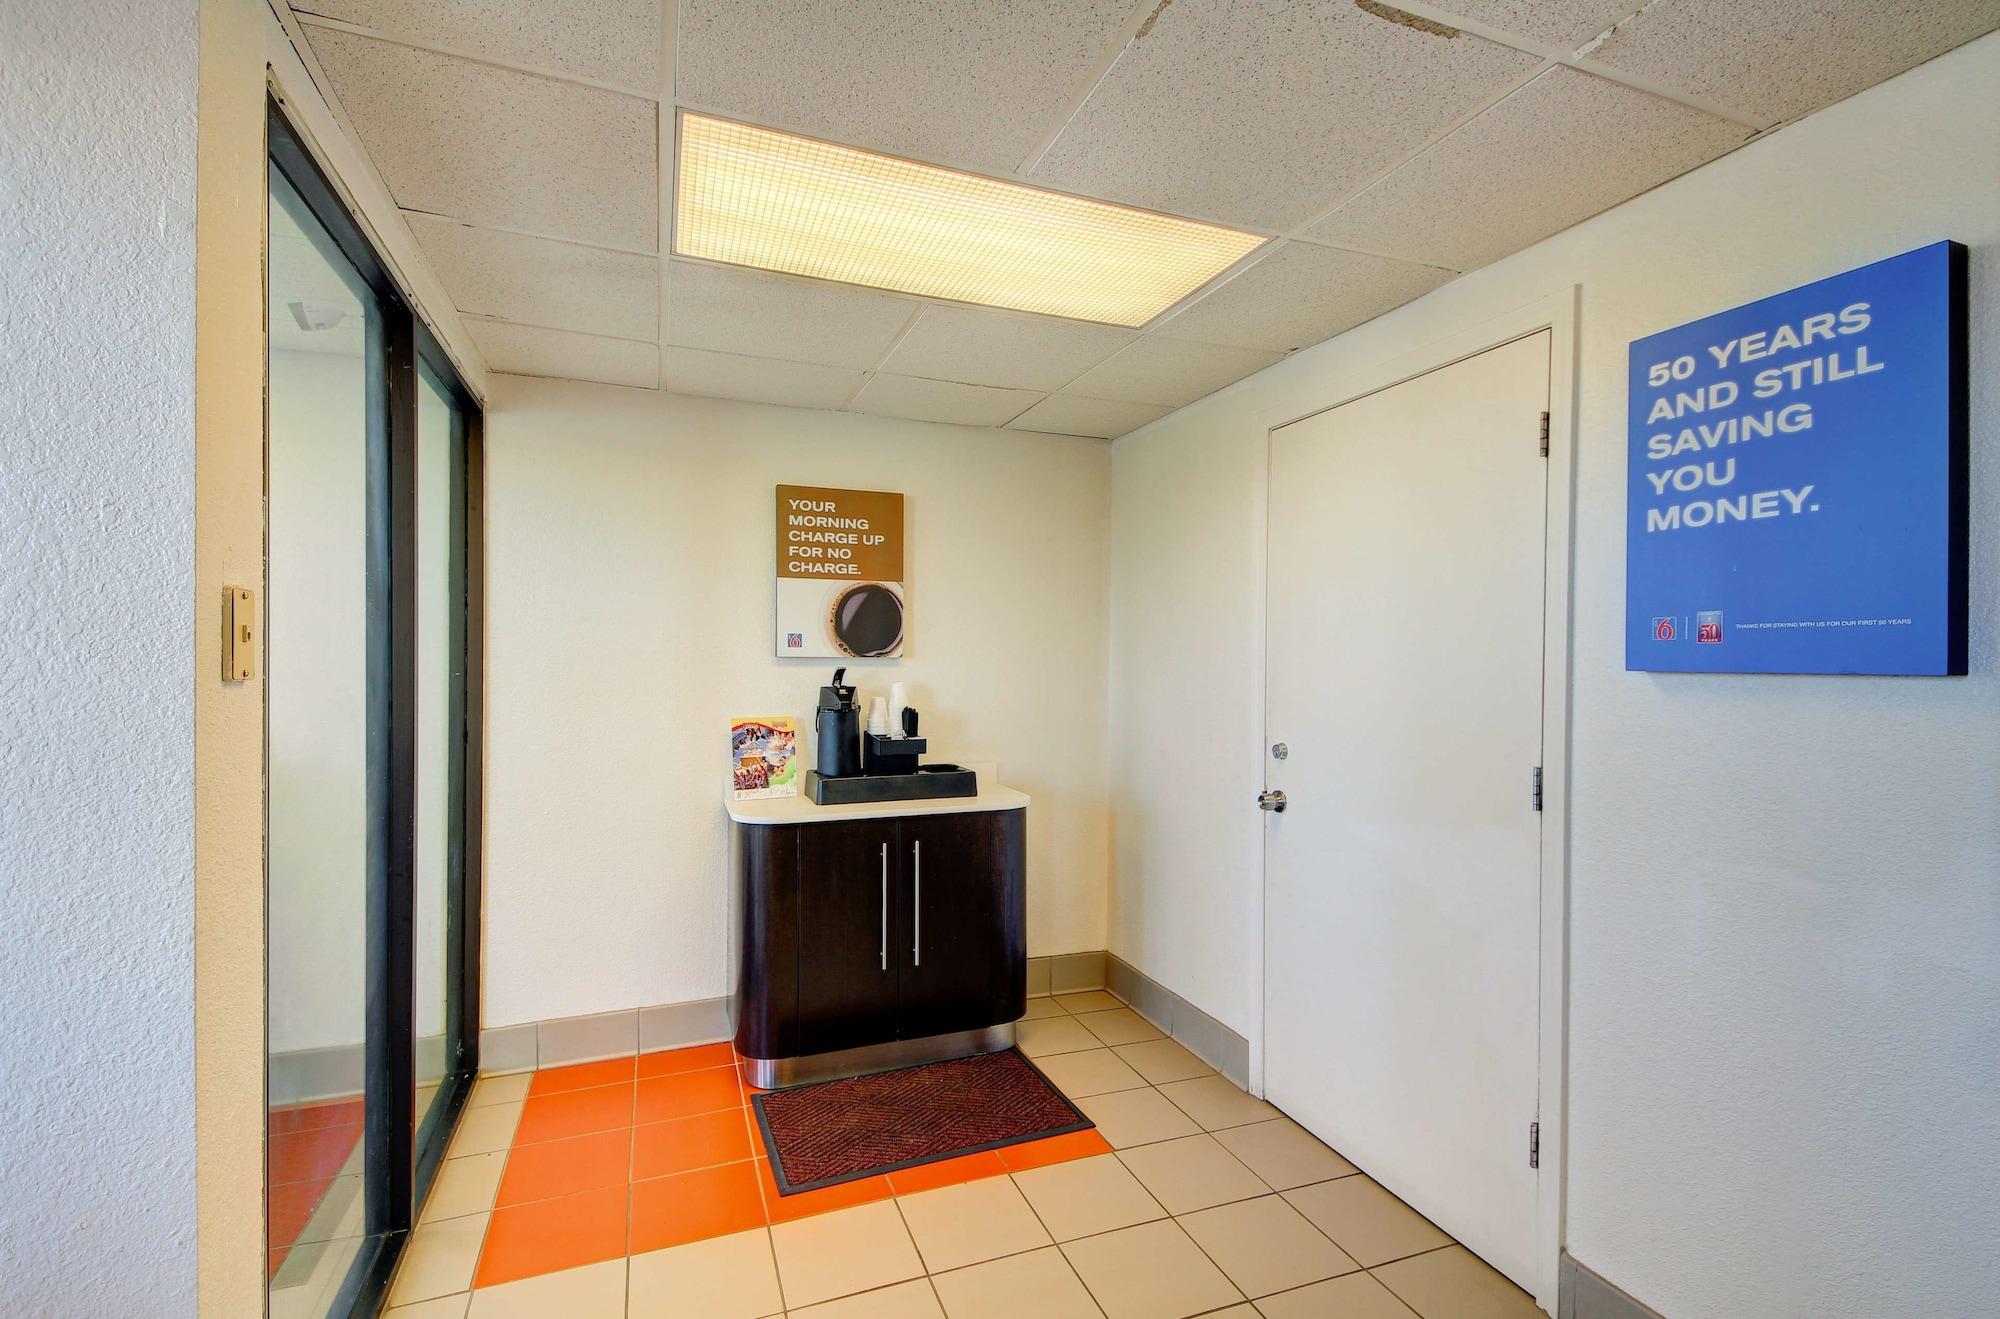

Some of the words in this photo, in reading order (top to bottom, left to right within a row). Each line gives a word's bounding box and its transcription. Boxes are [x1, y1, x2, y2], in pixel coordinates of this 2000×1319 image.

[1648, 355, 1695, 387] 50
[1708, 303, 1872, 369] YEARS
[1647, 381, 1738, 424] AND
[1753, 346, 1885, 398] STILL
[1647, 403, 1814, 459] SAVING
[1647, 458, 1736, 496] YOU
[788, 499, 836, 513] YOUR
[1647, 486, 1820, 532] MONEY.
[788, 515, 869, 530] MORNING
[788, 530, 858, 545] CHARGE
[863, 534, 885, 545] UP
[788, 546, 823, 558] FOR
[827, 548, 852, 560] NO
[788, 561, 862, 575] CHARGE.
[1656, 618, 1674, 641] 6
[1699, 623, 1721, 640] 50
